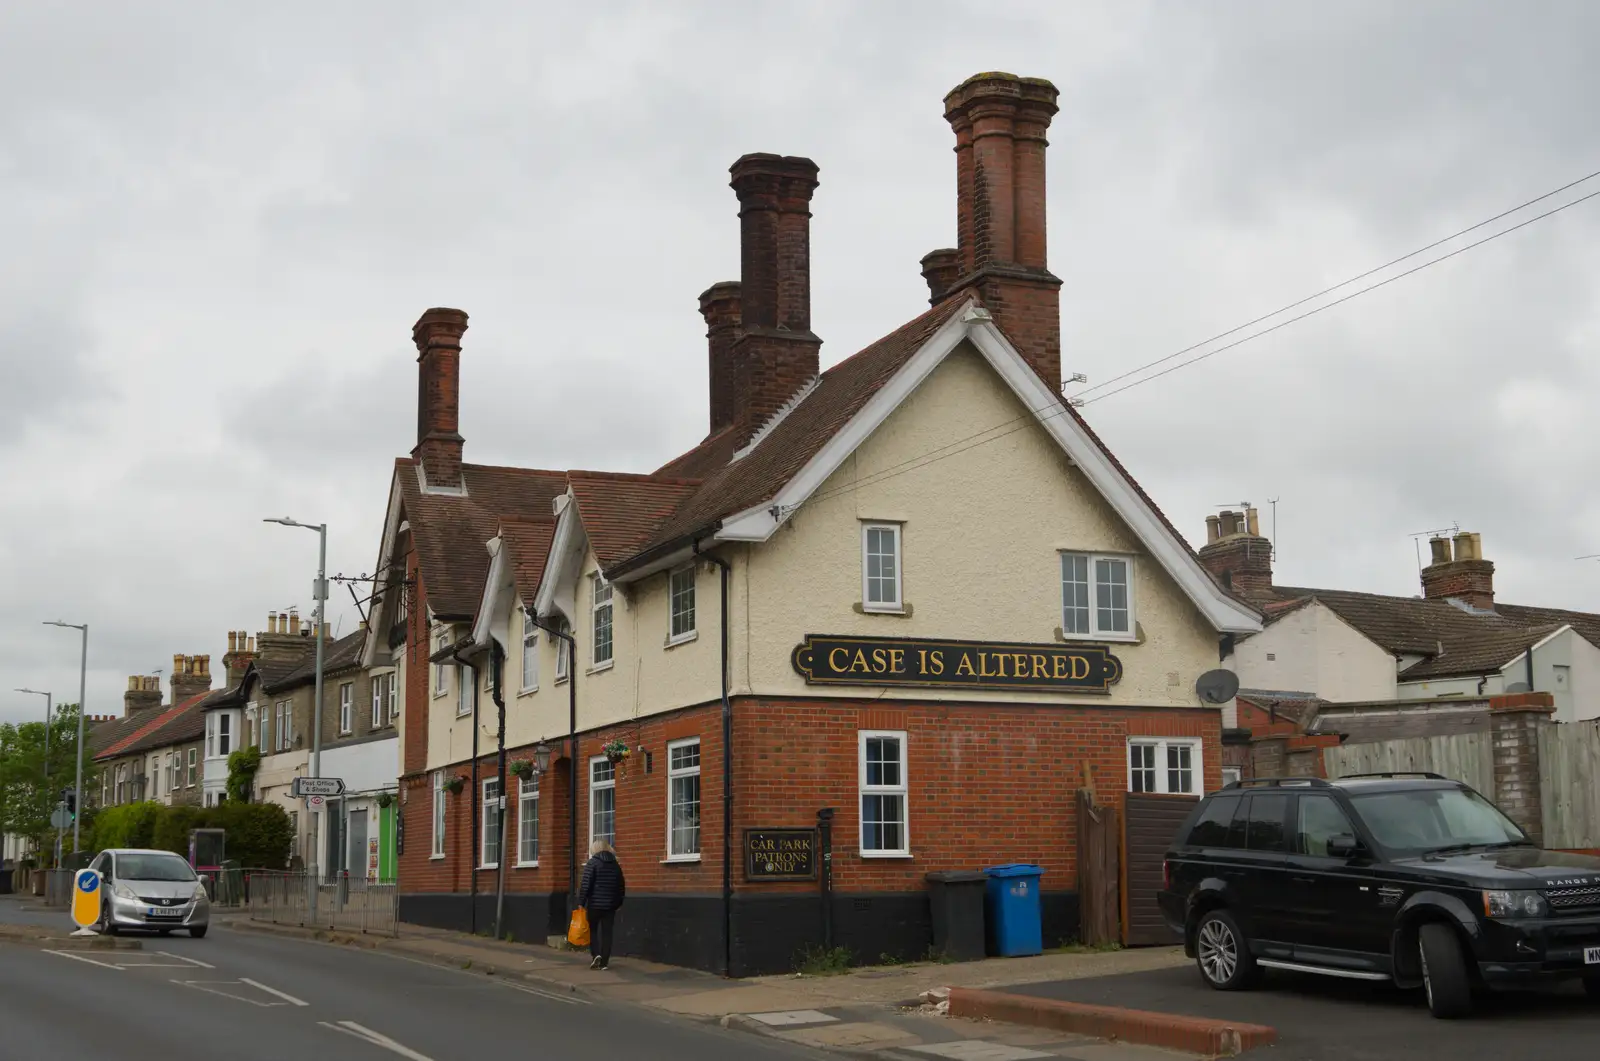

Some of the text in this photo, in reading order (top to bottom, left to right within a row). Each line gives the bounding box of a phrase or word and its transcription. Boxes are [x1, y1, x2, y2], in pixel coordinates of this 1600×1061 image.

[828, 647, 1090, 680] CASE IS ALTERED
[751, 839, 810, 850] CAR PARK
[755, 852, 808, 862] PATRONS
[765, 861, 796, 872] ONLY
[1546, 878, 1588, 886] RANGE
